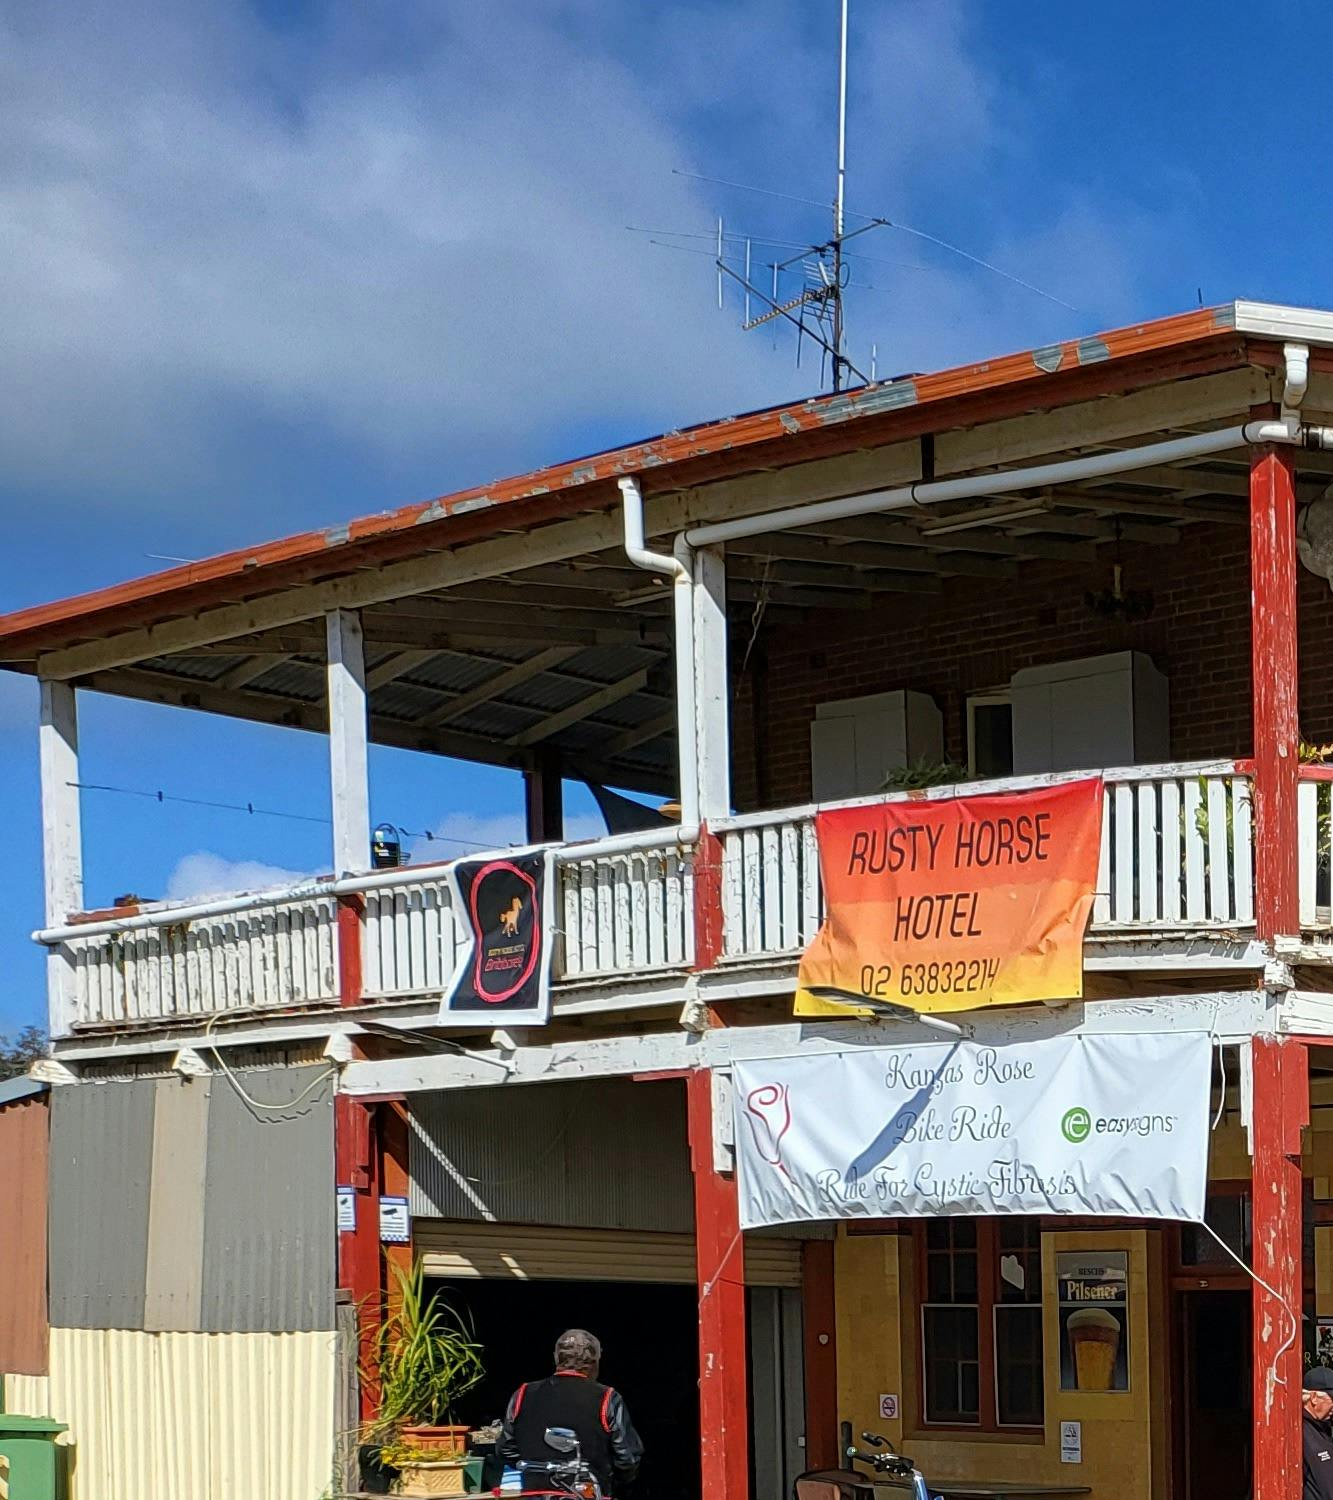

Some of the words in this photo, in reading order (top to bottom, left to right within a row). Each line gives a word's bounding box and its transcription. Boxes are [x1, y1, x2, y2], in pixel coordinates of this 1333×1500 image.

[847, 823, 945, 877] RUSTY
[953, 812, 1052, 869] HORSE
[893, 891, 983, 943] HOTEL
[860, 964, 892, 997] 02
[899, 956, 1001, 997] 63832214
[974, 1047, 1036, 1086] Rose
[892, 1108, 944, 1145] Bike
[948, 1105, 1012, 1142] Ride
[815, 1165, 871, 1202] Ride
[914, 1161, 985, 1209] Cystic
[1066, 1280, 1118, 1301] Pilsener
